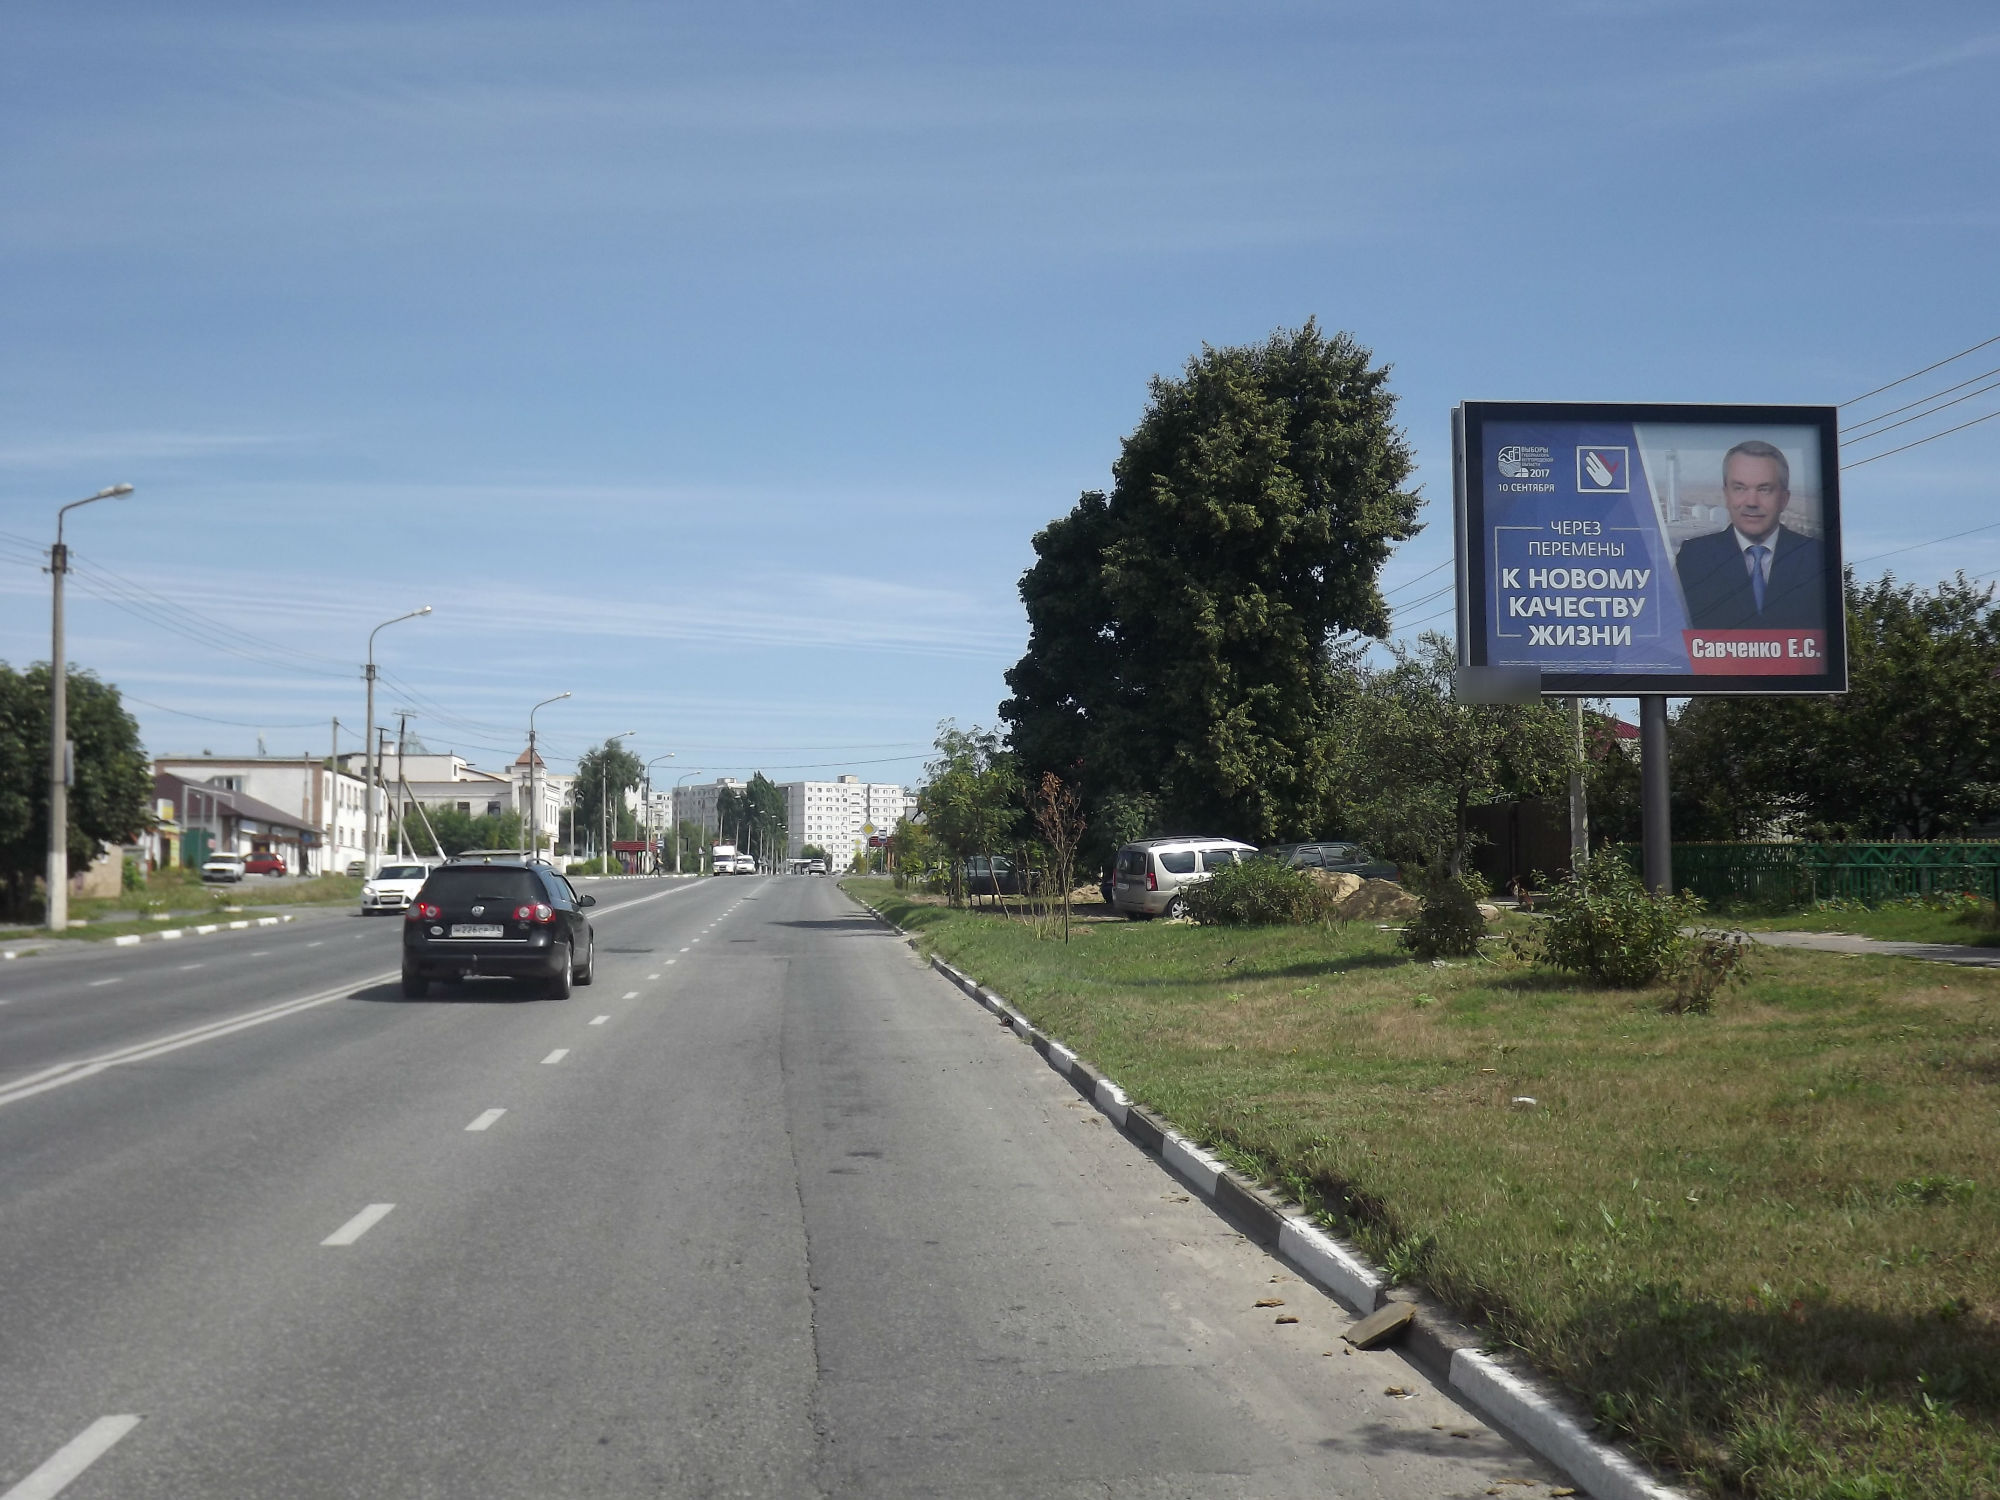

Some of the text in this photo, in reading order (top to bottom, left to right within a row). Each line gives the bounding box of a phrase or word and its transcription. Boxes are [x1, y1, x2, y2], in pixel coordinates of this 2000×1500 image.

[1529, 468, 1550, 478] 2017
[1499, 483, 1555, 492] 10 СЕНТЯБРЯ
[1551, 520, 1601, 535] ЧЕРЕЗ
[1528, 541, 1625, 557] ПЕРЕМЕНЫ
[1502, 568, 1651, 589] К НОВОМУ
[1509, 596, 1646, 618] КАЧЕСТВУ
[1528, 625, 1632, 646] ЖИЗНИ
[1691, 638, 1821, 658] Савченко Е.С.
